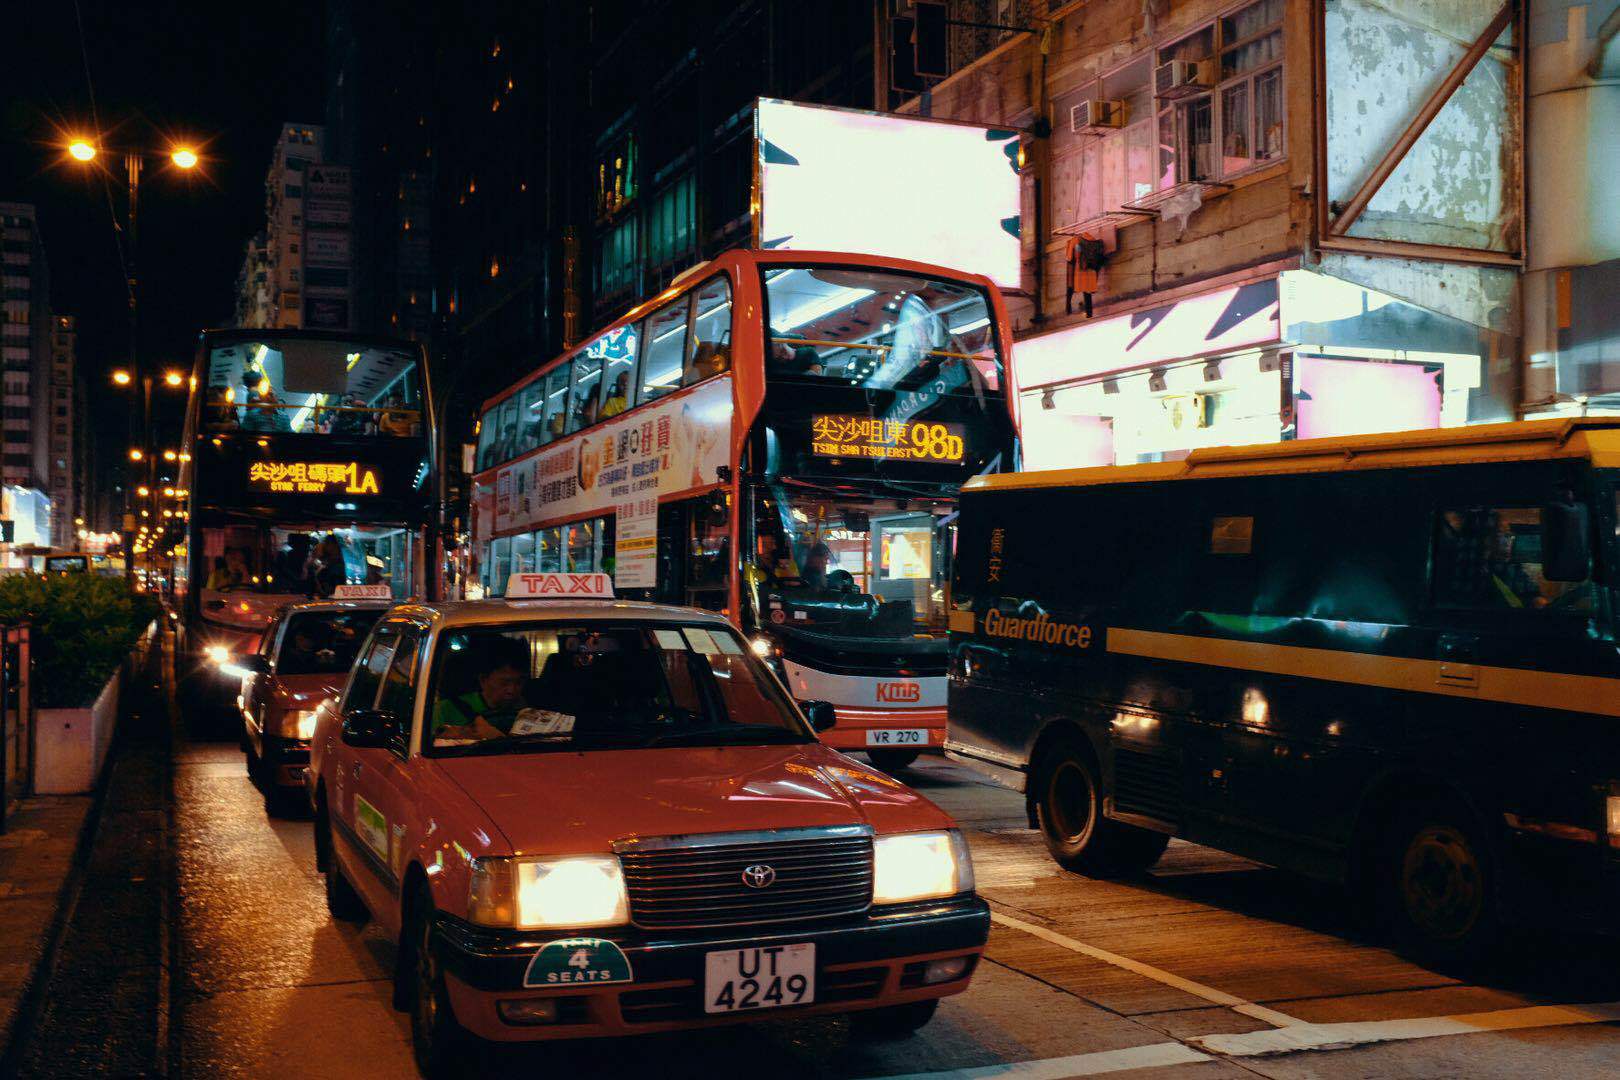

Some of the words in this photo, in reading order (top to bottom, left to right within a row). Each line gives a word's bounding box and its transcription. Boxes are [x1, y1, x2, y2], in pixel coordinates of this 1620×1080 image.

[813, 416, 909, 445] 尖沙咀東
[911, 423, 964, 460] 98D
[887, 447, 912, 458] EAST
[270, 481, 294, 491] STAR
[297, 482, 325, 492] FERRY
[345, 462, 378, 493] 1A
[340, 586, 387, 596] TAXI
[521, 574, 605, 593] TAXI
[984, 607, 1092, 649] Guardforce
[876, 682, 920, 702] KMB
[873, 731, 890, 743] VR
[896, 731, 920, 743] 270
[568, 948, 590, 969] 4
[738, 947, 784, 979] UT
[546, 970, 611, 983] SEATS
[713, 974, 808, 1010] 4249
